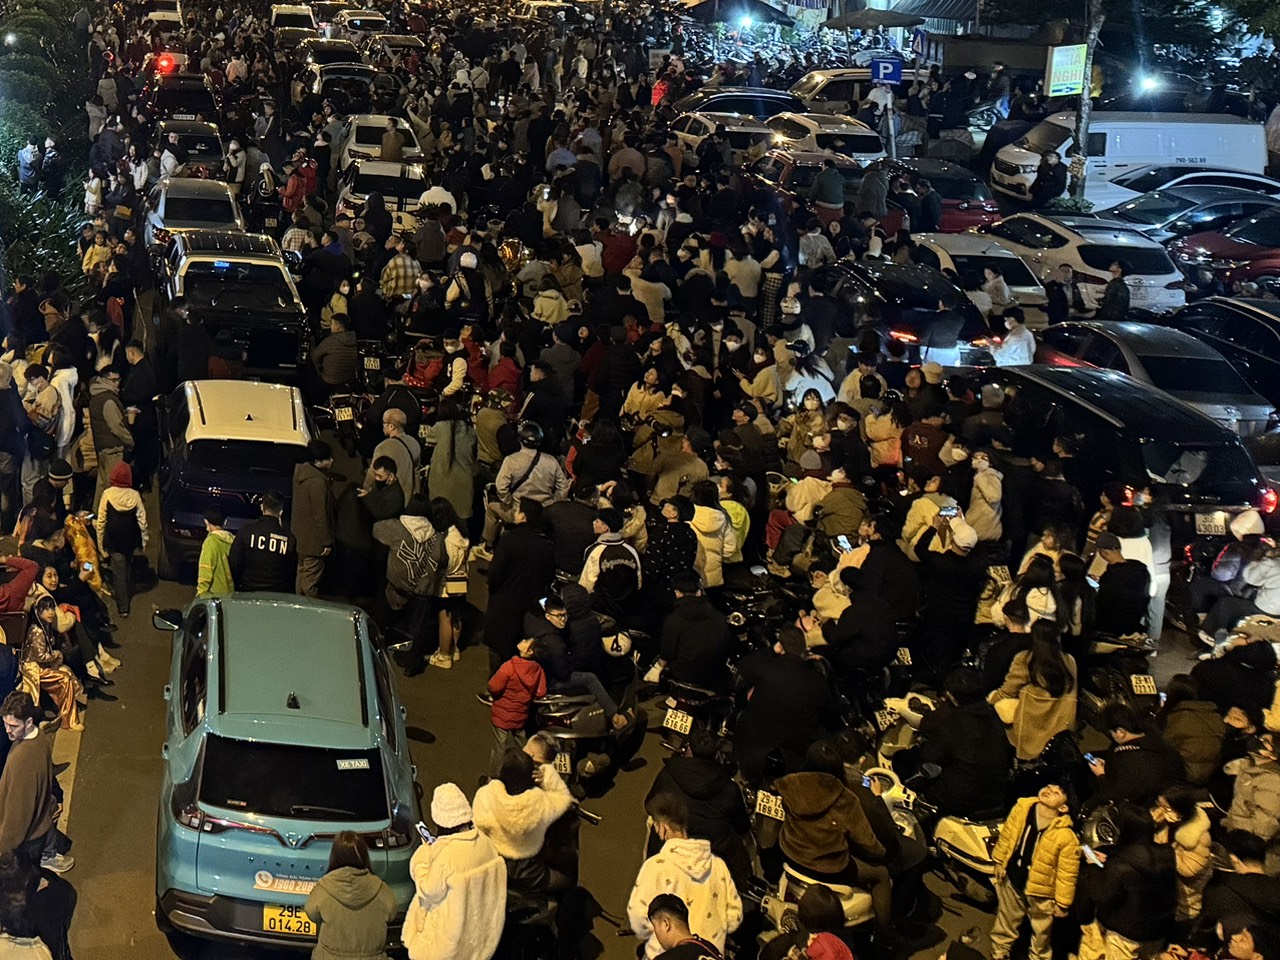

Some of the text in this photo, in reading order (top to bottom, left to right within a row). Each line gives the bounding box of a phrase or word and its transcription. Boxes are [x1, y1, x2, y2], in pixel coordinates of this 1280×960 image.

[879, 62, 894, 79] P
[250, 534, 288, 555] ICON
[273, 878, 295, 891] 1900
[278, 905, 302, 918] 29E
[268, 918, 311, 934] 014.28
